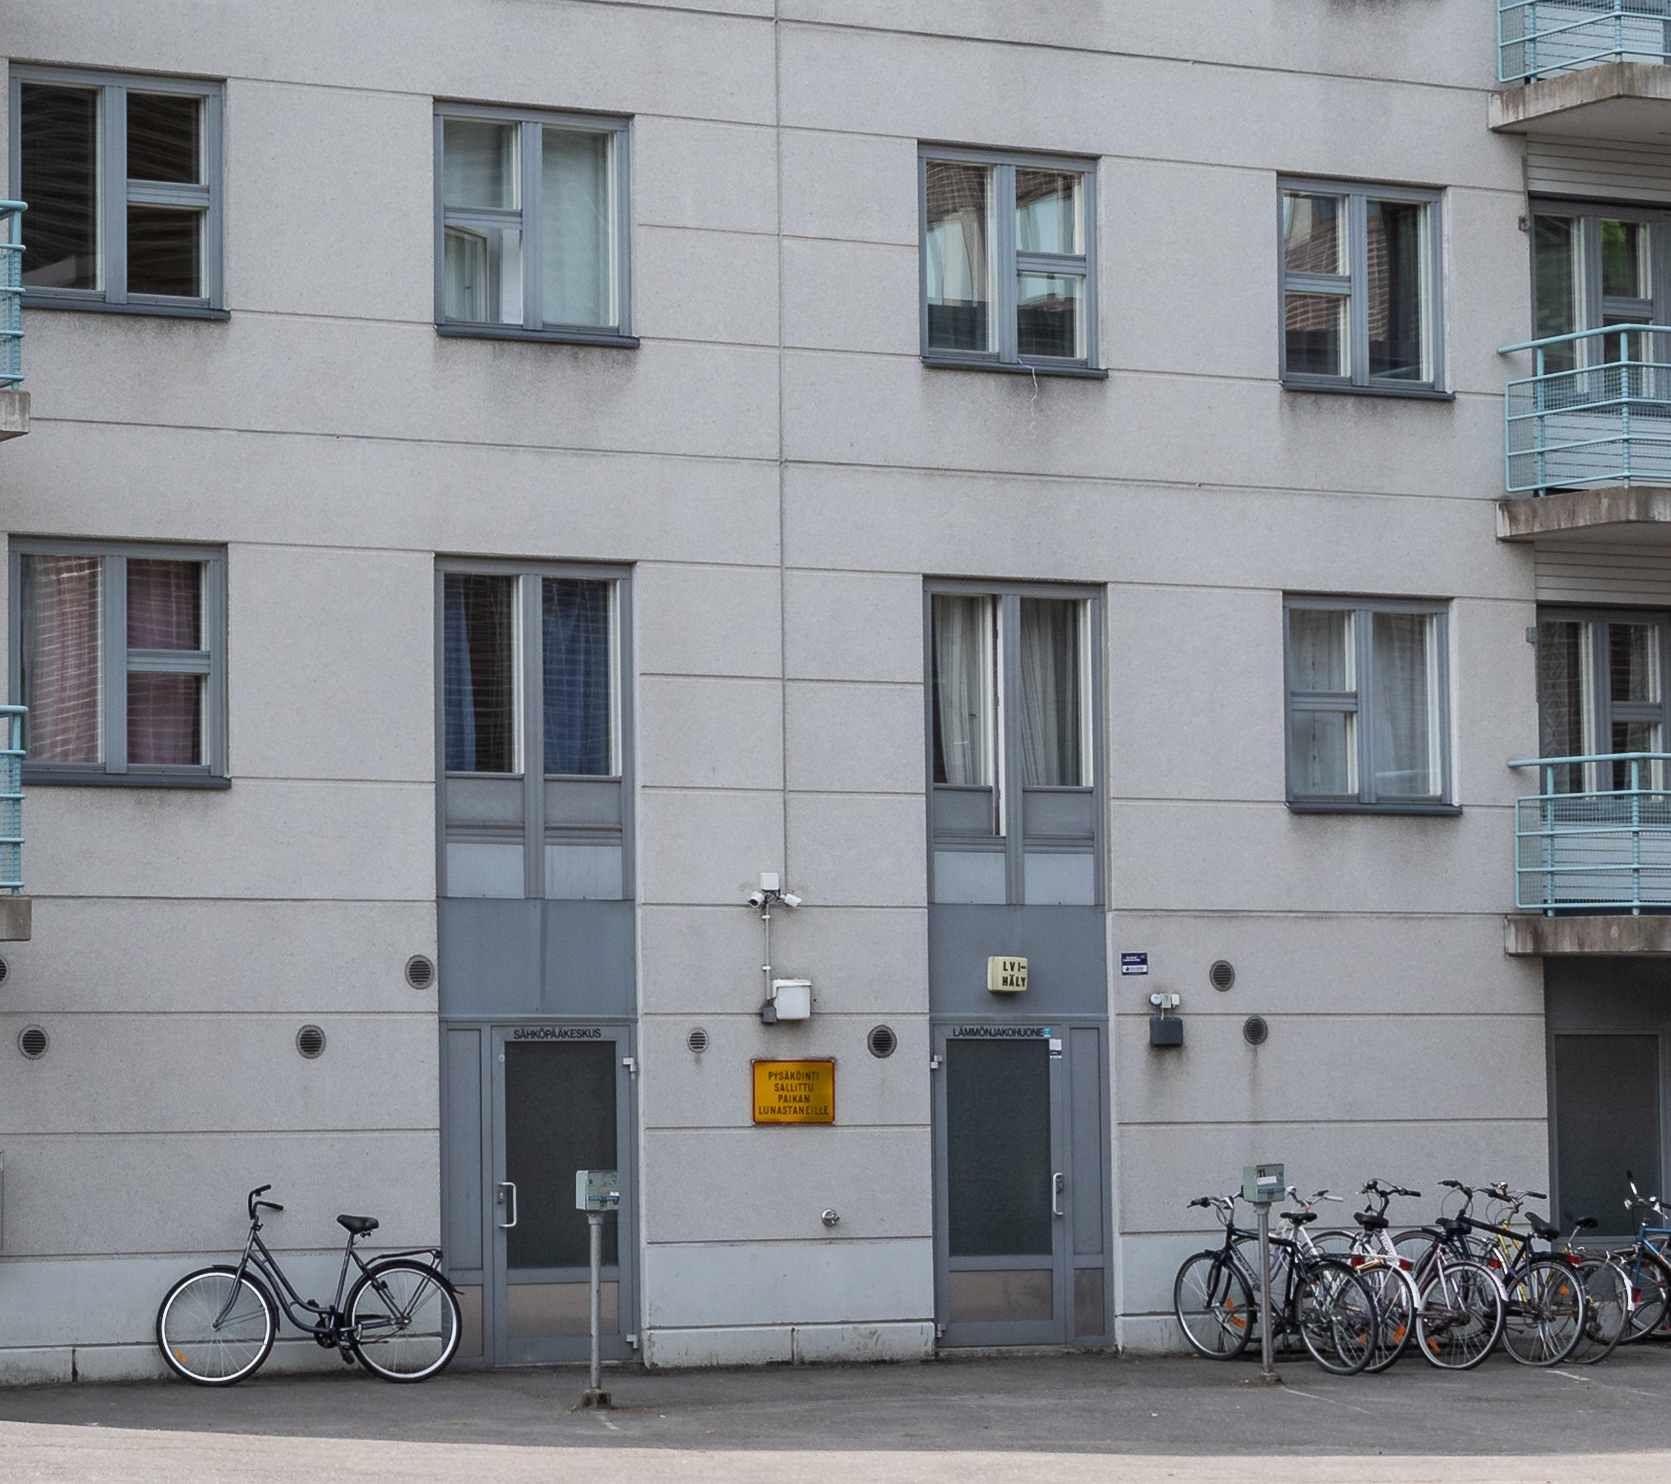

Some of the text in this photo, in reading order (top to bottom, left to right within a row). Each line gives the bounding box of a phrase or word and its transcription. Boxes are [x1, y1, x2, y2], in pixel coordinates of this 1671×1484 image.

[1002, 974, 1027, 988] HÄLY
[513, 1027, 602, 1039] SÄHKÖPÄÄKESKUS
[952, 1026, 1044, 1037] LÄMMÖNJAKOHUONE
[768, 1070, 820, 1081] PYSÄKÖINTI
[774, 1083, 814, 1092] SALLITTU
[778, 1094, 810, 1103] PAIKAN
[759, 1105, 829, 1115] LUNASTANEILLE
